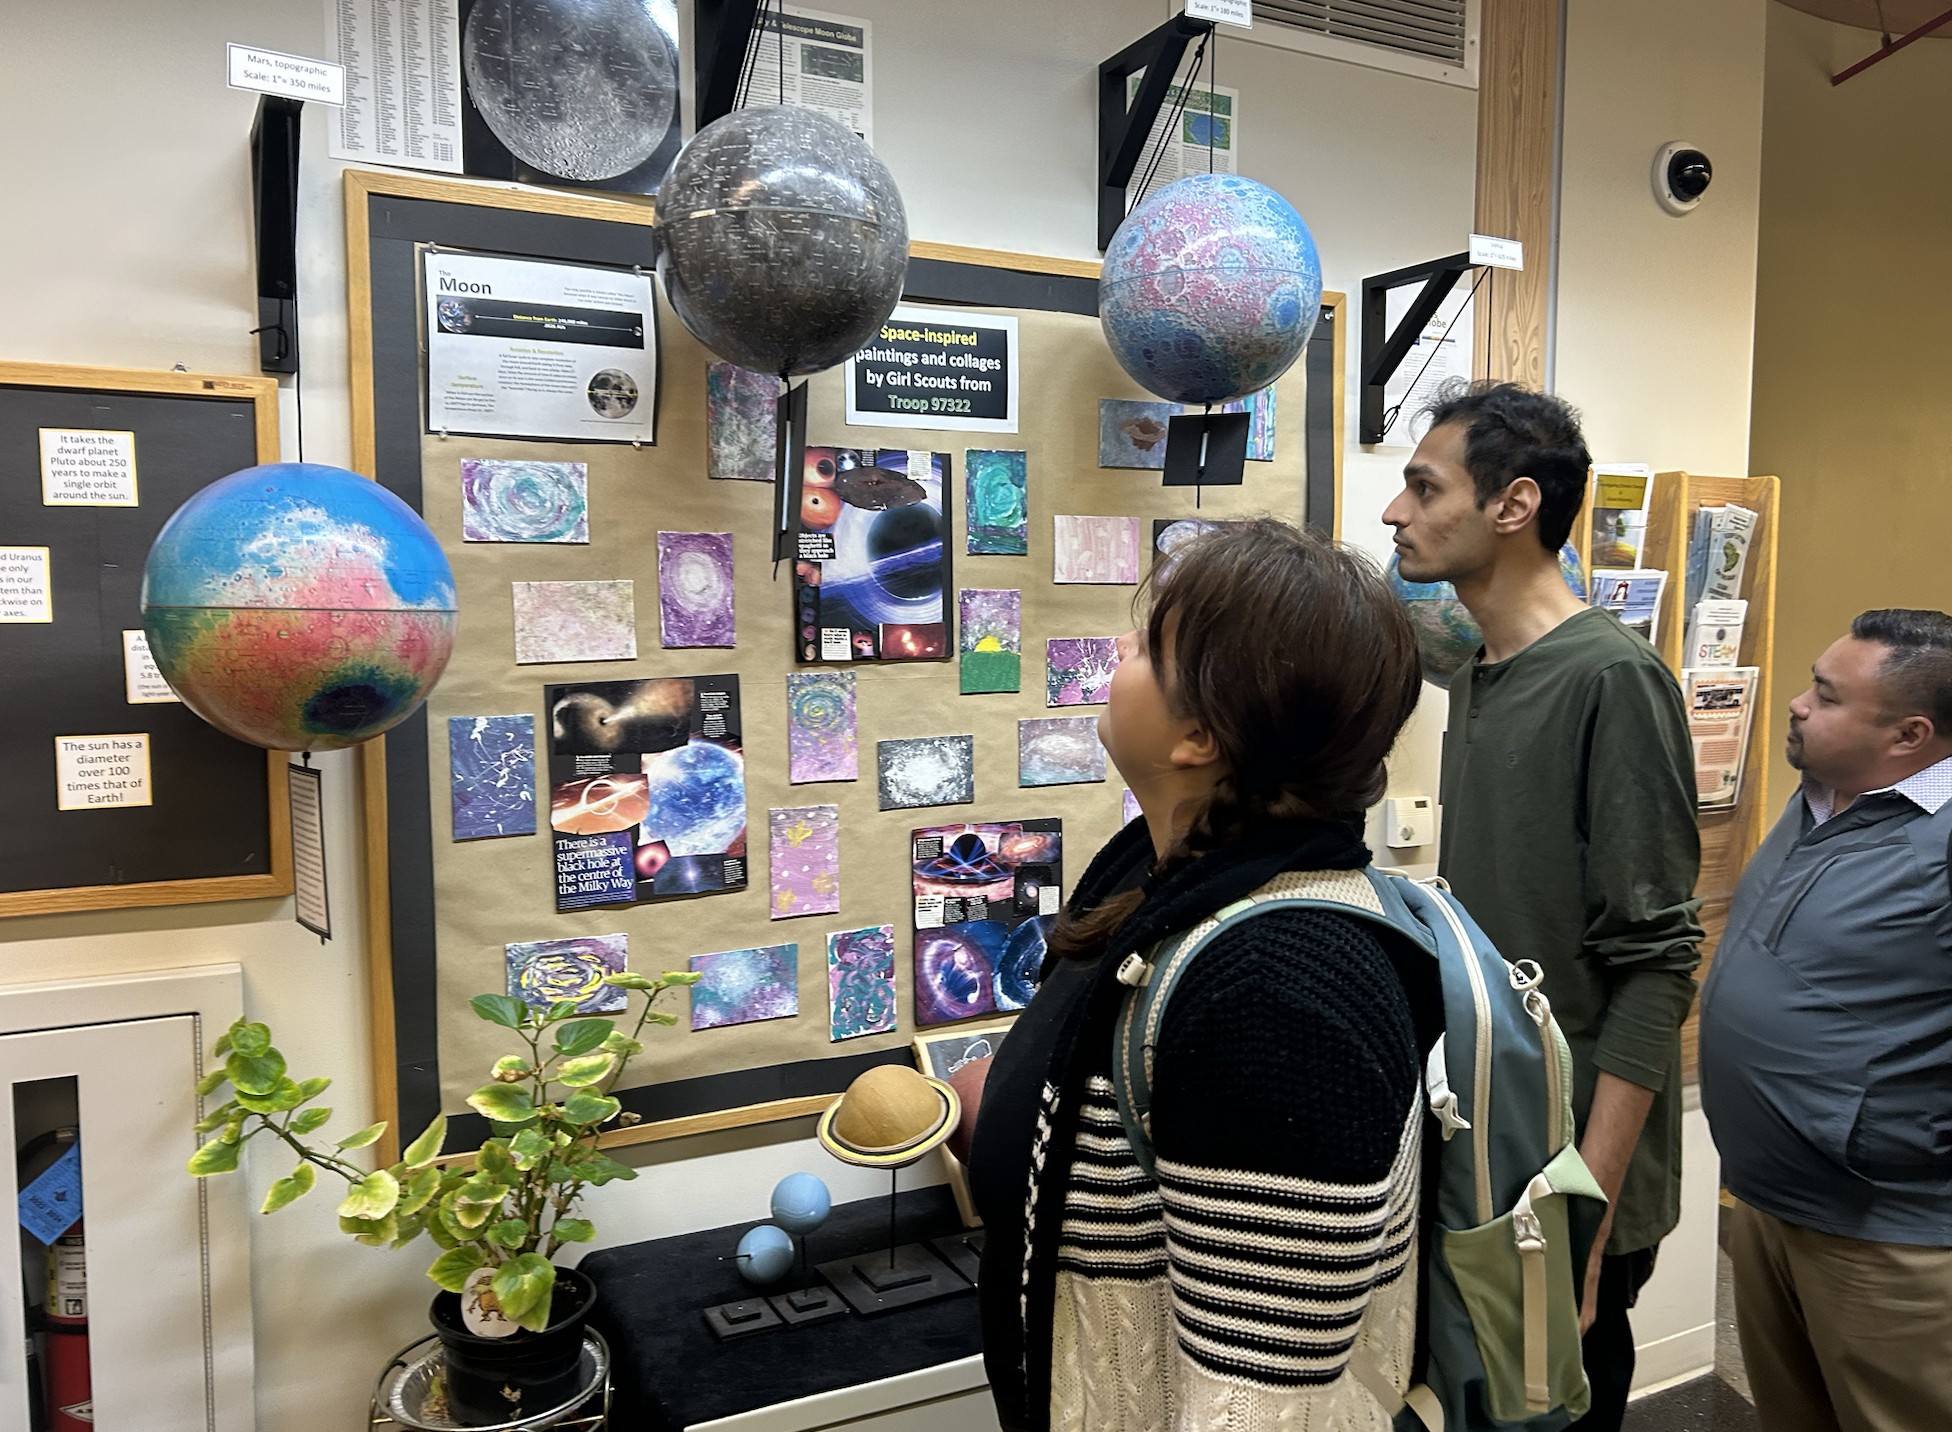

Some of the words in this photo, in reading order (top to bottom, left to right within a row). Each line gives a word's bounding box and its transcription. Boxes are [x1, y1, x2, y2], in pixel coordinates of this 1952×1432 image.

[1231, 10, 1244, 18] miles
[815, 28, 834, 38] Moon
[248, 54, 272, 67] Mars,
[275, 60, 327, 76] topographic
[244, 70, 270, 82] Scale:
[290, 78, 306, 88] 350
[308, 80, 331, 93] miles
[440, 277, 492, 295] Moon
[880, 325, 978, 346] Space-inspired
[856, 347, 918, 366] paintings
[921, 351, 946, 366] and
[949, 353, 1001, 372] collages
[866, 369, 884, 387] by
[886, 371, 910, 387] Girl
[914, 373, 957, 390] Scouts
[960, 376, 992, 392] from
[888, 394, 928, 413] Troop
[931, 397, 971, 413] 97322
[60, 435, 68, 443] It
[70, 436, 95, 444] takes
[98, 436, 114, 444] the
[58, 446, 85, 455] dwarf
[88, 448, 118, 458] planet
[51, 457, 75, 466] Pluto
[78, 458, 106, 466] about
[109, 459, 126, 467] 250
[52, 470, 77, 478] years
[93, 469, 118, 477] make
[64, 480, 91, 490] single
[93, 481, 117, 489] orbit
[90, 492, 106, 500] the
[10, 553, 42, 561] Uranus
[9, 564, 28, 573] only
[1699, 644, 1737, 658] STEAM
[63, 742, 85, 751] The
[113, 740, 132, 749] has
[136, 741, 142, 749] a
[77, 754, 131, 764] diameter
[78, 769, 104, 777] over
[110, 766, 130, 776] 100
[67, 782, 100, 791] times
[103, 780, 126, 789] that
[130, 778, 143, 788] of
[88, 793, 123, 804] Earth!
[556, 839, 587, 850] There
[589, 837, 598, 846] is
[600, 838, 607, 846] a
[557, 845, 628, 862] supermassive
[557, 860, 586, 872] black
[587, 858, 610, 869] hole
[611, 857, 621, 867] at
[558, 873, 576, 883] the
[578, 870, 610, 881] centre
[612, 866, 624, 878] of
[558, 884, 577, 894] the
[578, 880, 609, 892] Milky
[610, 878, 633, 889] Way
